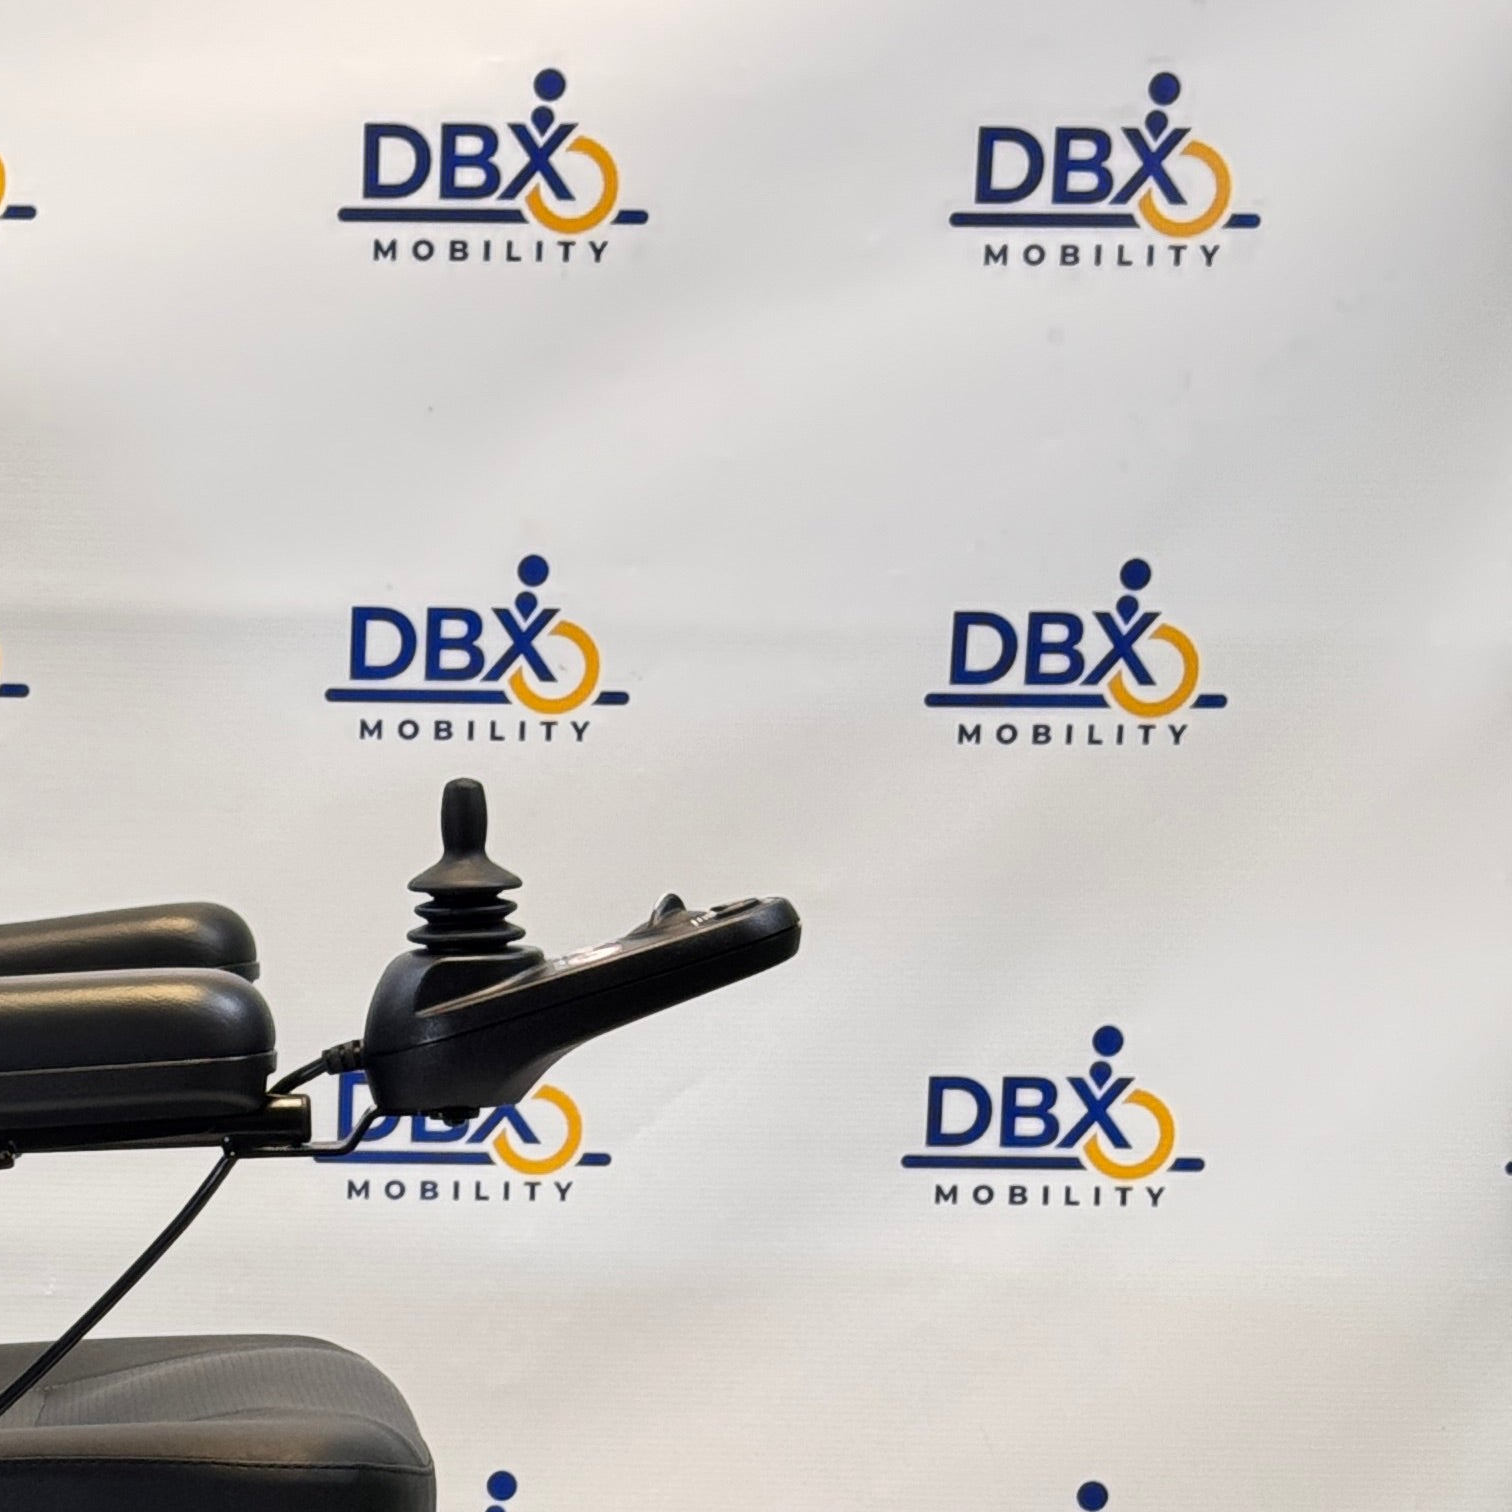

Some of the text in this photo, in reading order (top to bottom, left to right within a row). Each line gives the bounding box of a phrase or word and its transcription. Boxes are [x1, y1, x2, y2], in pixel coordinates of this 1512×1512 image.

[363, 123, 577, 201] DBX
[976, 127, 1190, 204] DBX
[374, 239, 609, 263] MOBILITY
[984, 243, 1220, 268] MOBILITY
[350, 607, 561, 681] DBX
[950, 611, 1160, 686] DBX
[359, 719, 591, 743] MOBILITY
[958, 723, 1187, 747] MOBILITY
[925, 1075, 1135, 1149] DBX
[347, 1180, 573, 1201] MOBILITY
[934, 1185, 1165, 1207] MOBILITY
